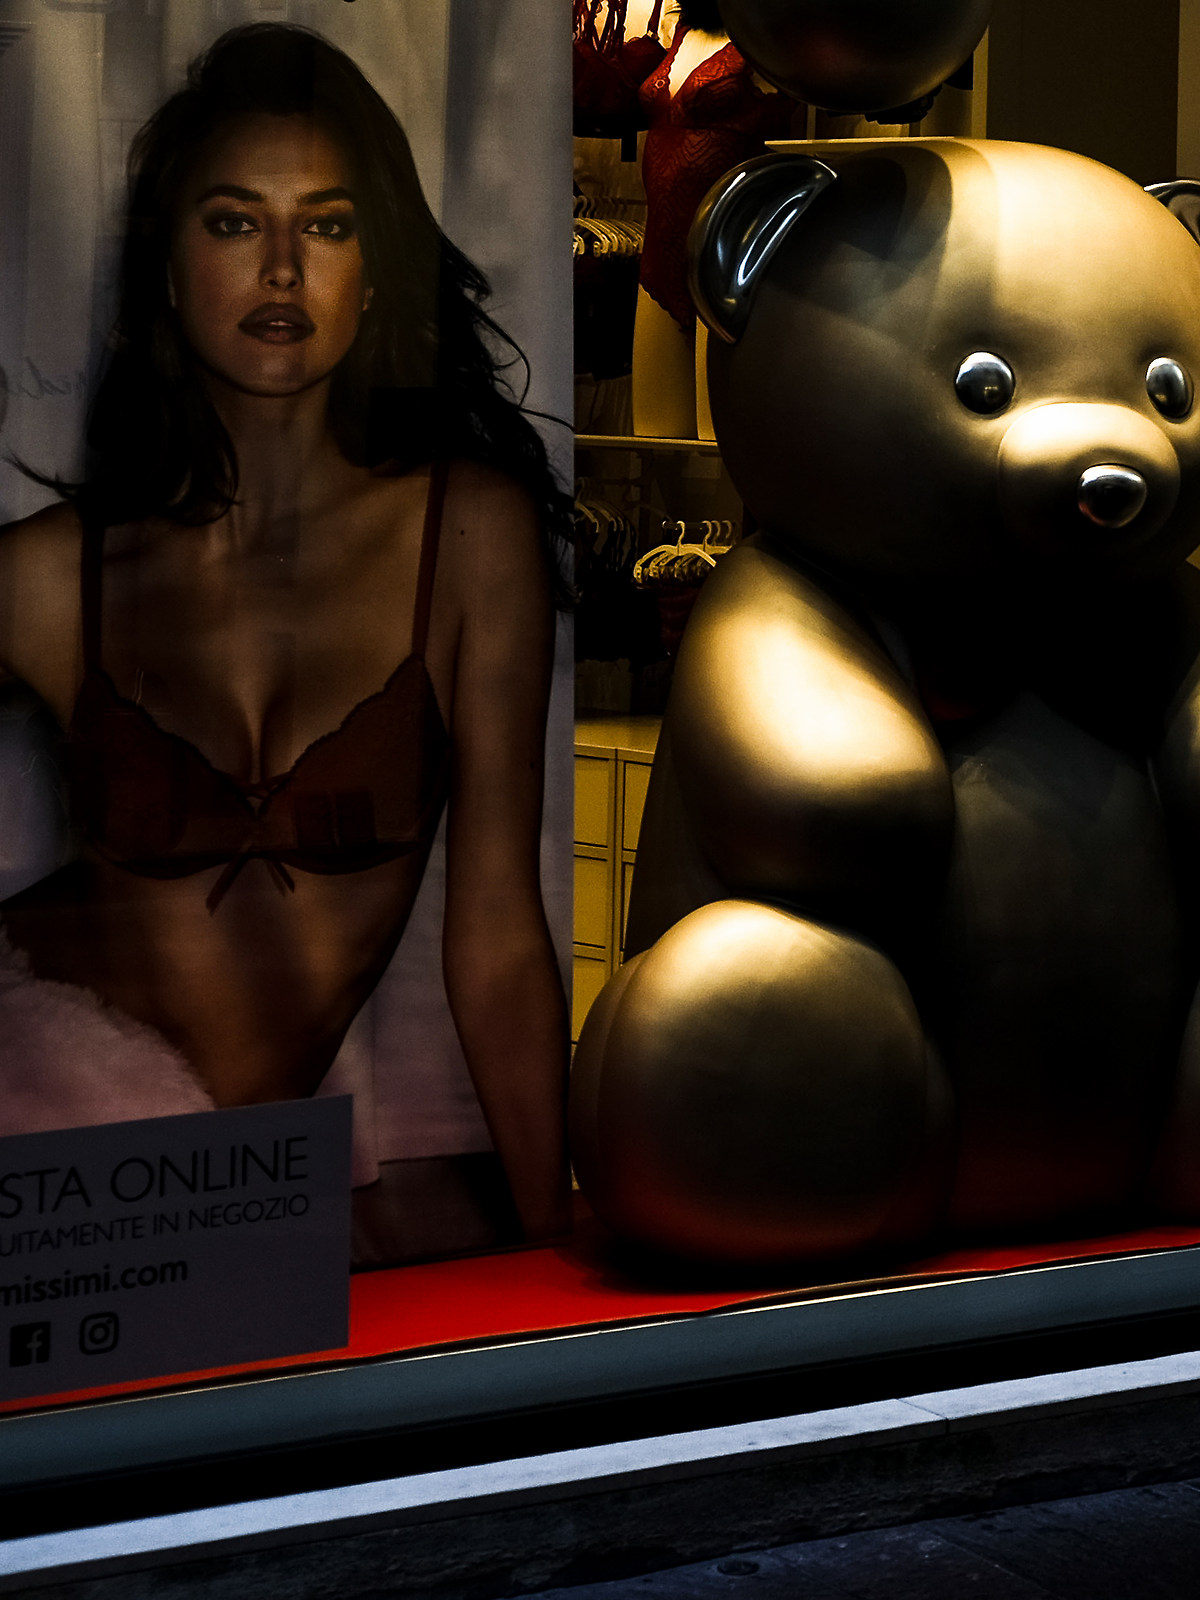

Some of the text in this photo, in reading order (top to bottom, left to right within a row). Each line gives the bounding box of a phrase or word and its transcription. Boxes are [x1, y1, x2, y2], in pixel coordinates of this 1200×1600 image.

[111, 1136, 308, 1202] ONLINE
[153, 1211, 179, 1235] IN
[188, 1194, 309, 1230] NEGOZIO
